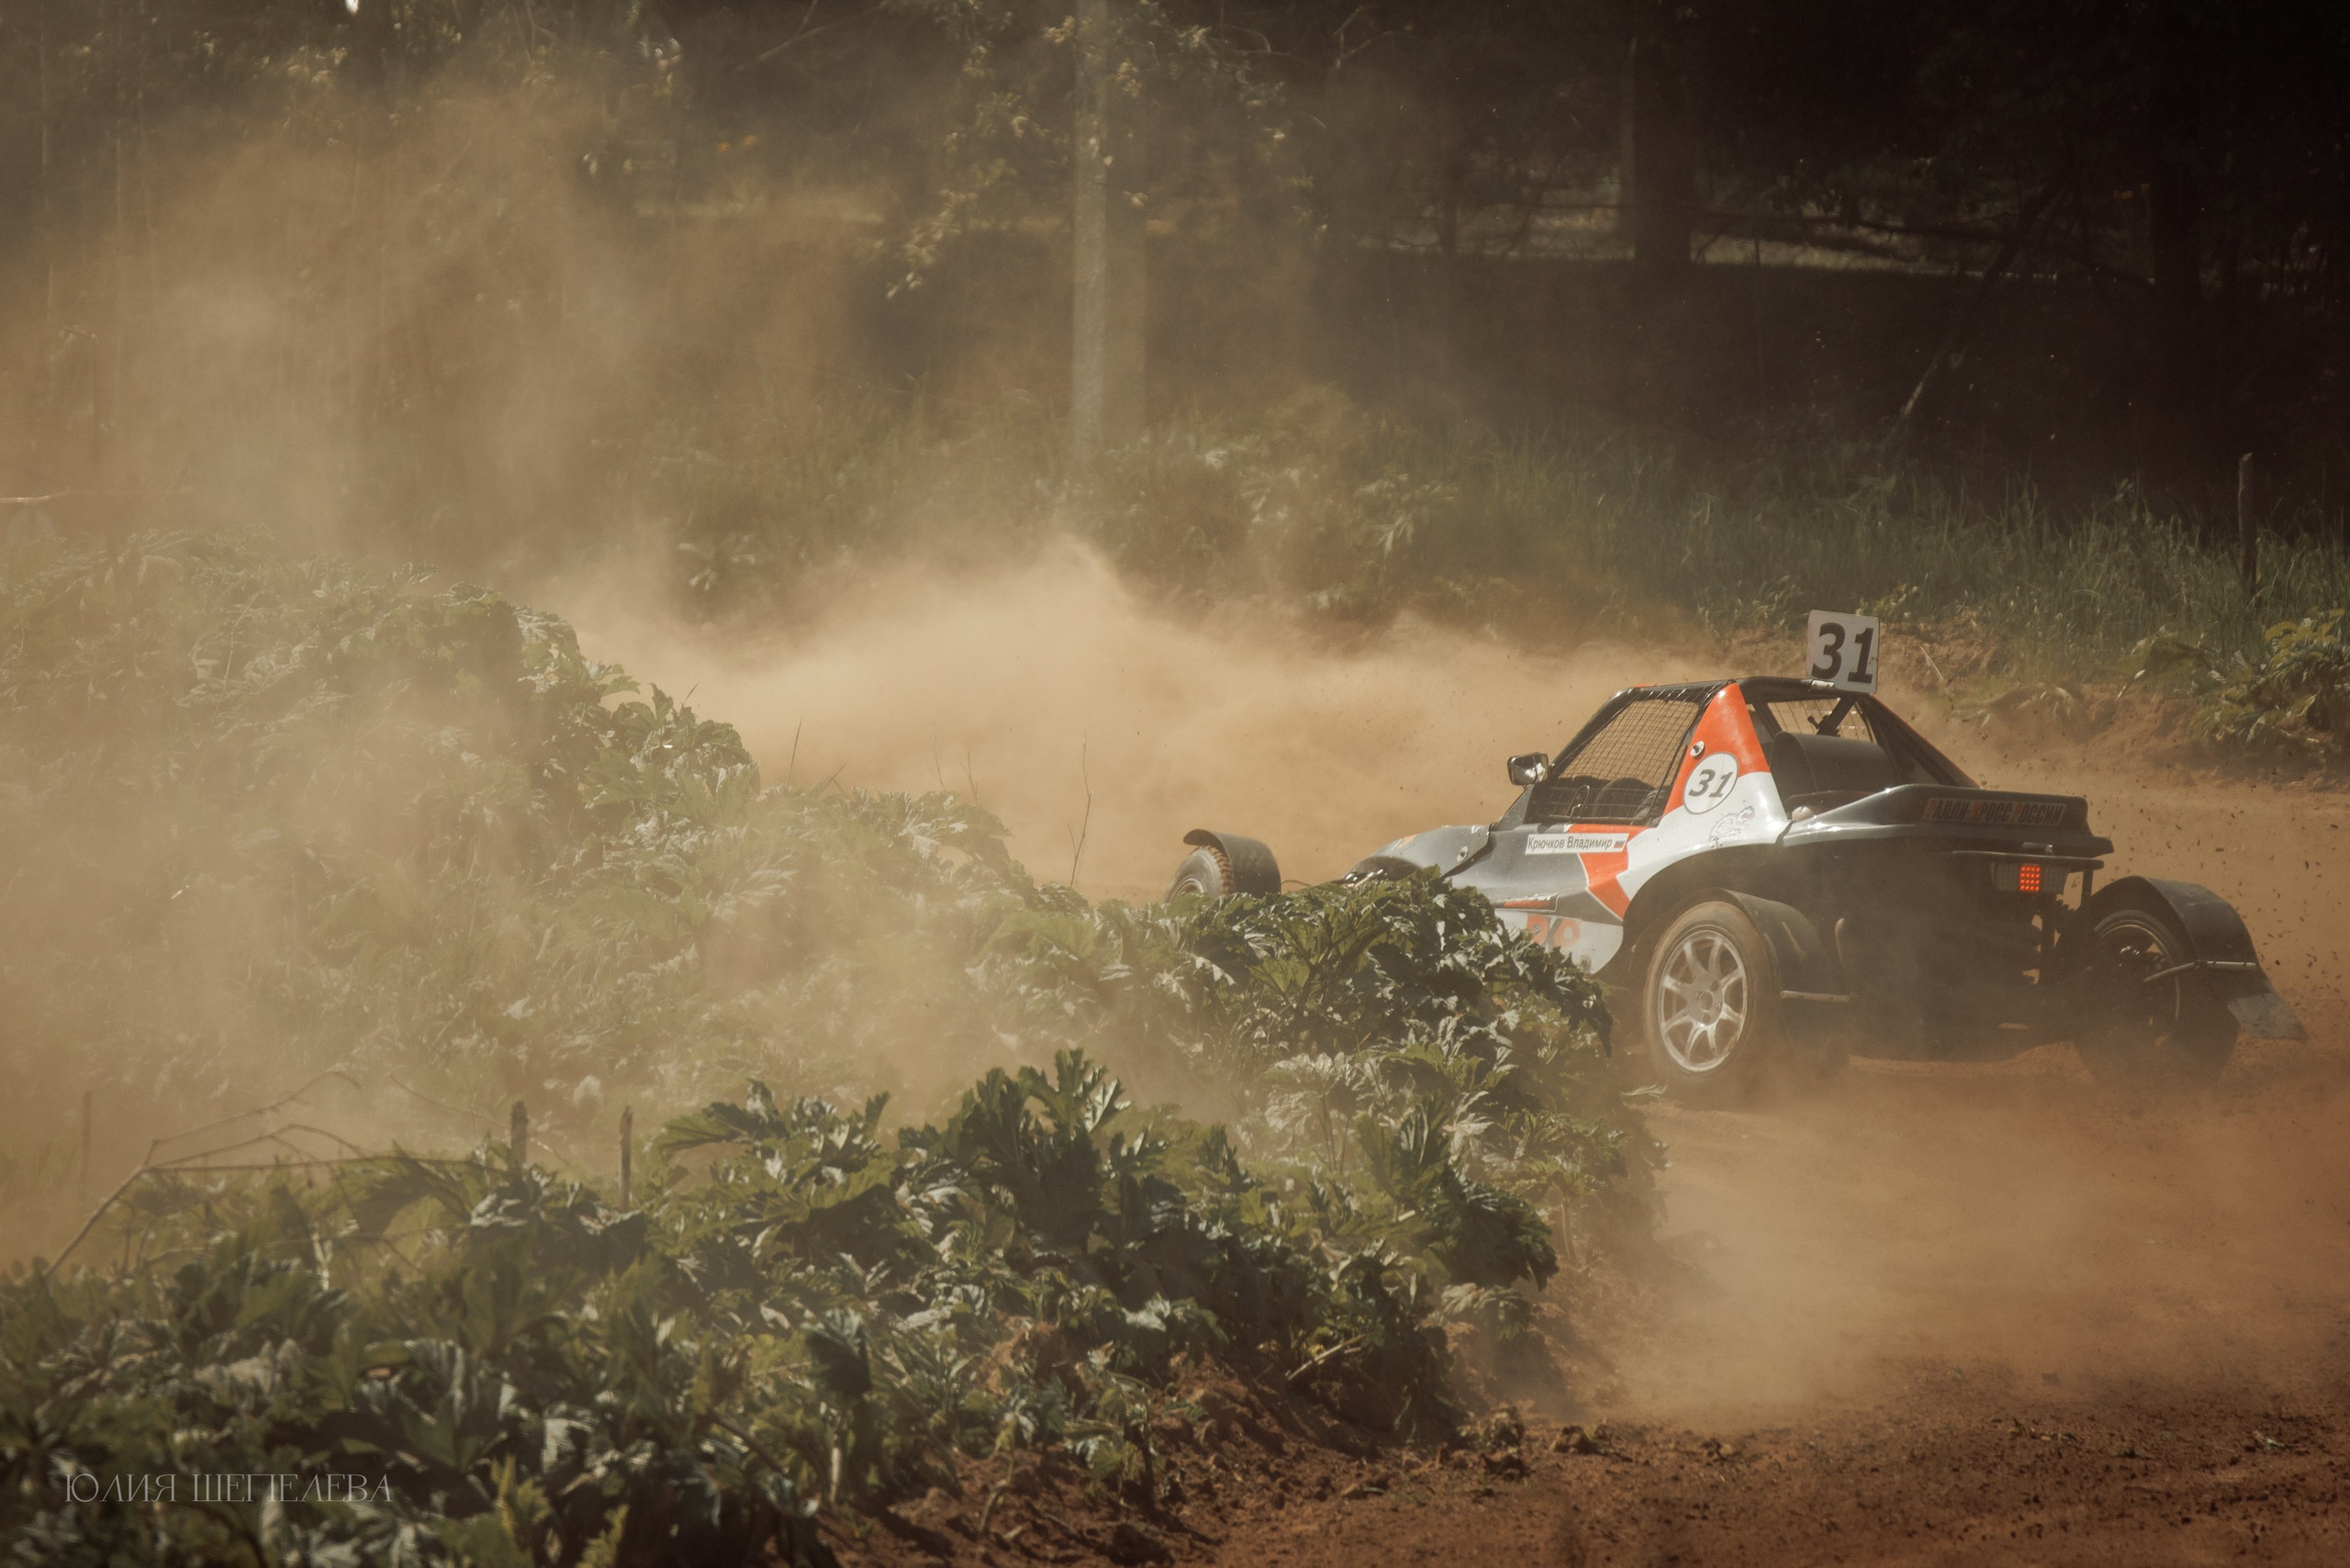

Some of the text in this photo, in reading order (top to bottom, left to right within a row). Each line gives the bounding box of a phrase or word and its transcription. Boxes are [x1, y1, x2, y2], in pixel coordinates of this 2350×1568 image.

[1811, 622, 1874, 684] 31
[1688, 768, 1734, 799] 31
[1528, 835, 1613, 852] Крючков Владимир
